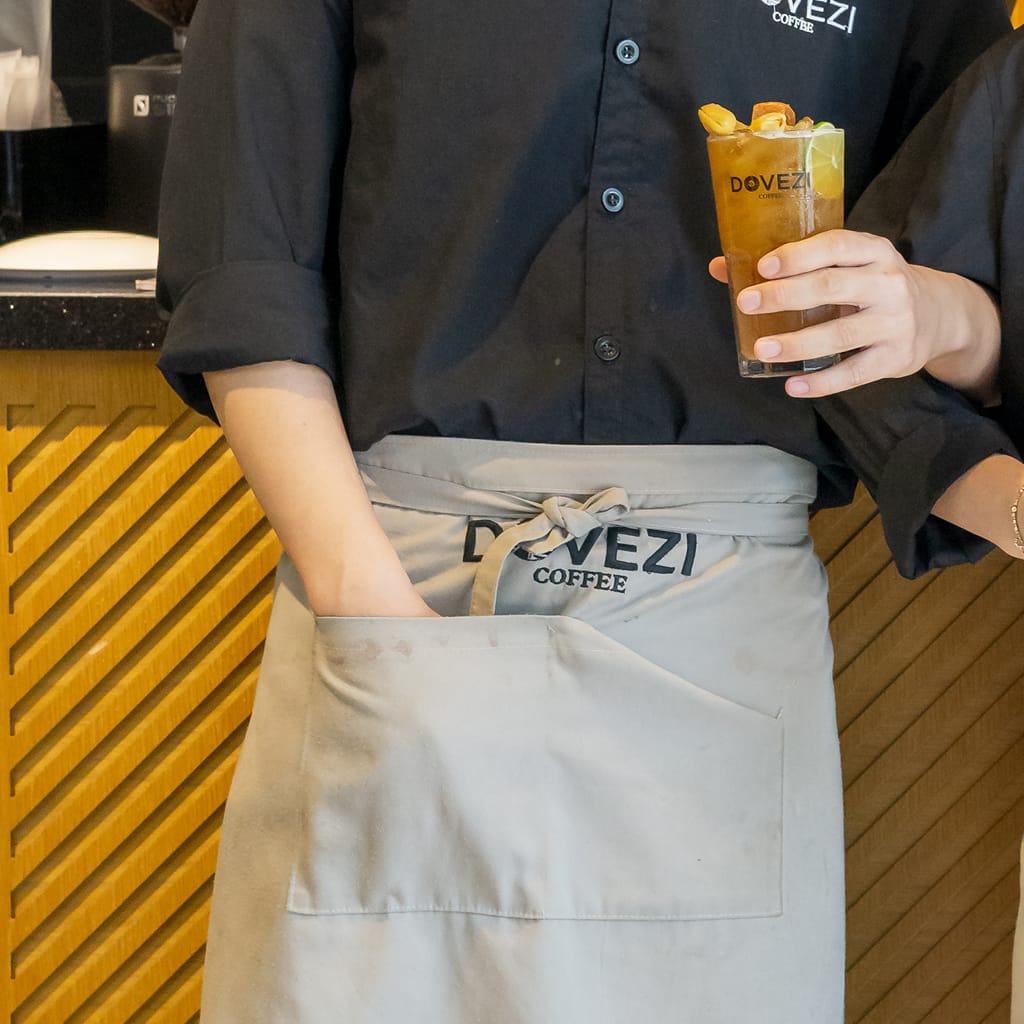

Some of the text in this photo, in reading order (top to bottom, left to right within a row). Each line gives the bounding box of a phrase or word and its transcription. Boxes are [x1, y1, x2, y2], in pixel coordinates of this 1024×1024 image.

[772, 11, 814, 34] COFFEE
[730, 172, 811, 192] DOVEZI
[463, 519, 697, 576] DVEZI
[533, 566, 628, 594] COFFEE
